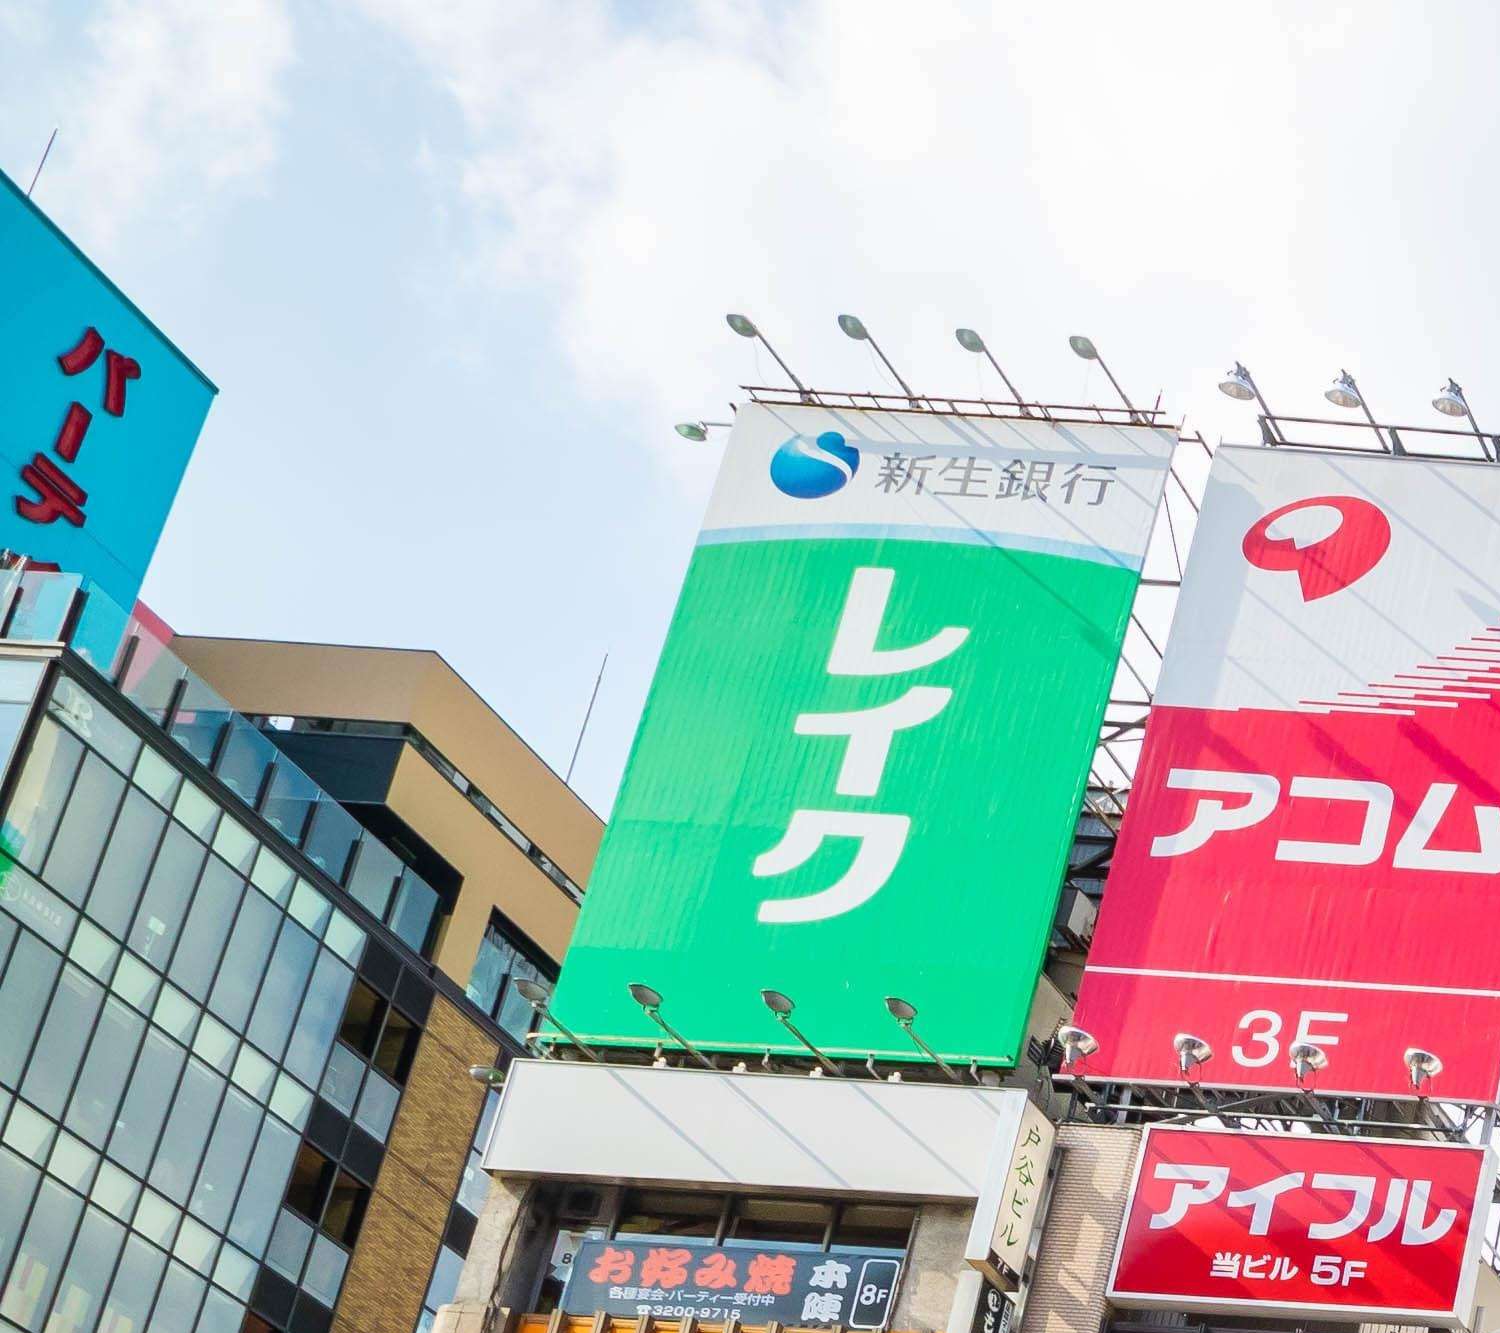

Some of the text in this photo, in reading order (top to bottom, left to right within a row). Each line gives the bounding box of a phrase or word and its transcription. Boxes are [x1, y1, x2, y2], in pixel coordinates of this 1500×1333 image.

[874, 452, 1118, 506] 新生銀行
[751, 567, 971, 924] レイク
[1230, 1009, 1349, 1070] 3F
[1000, 1125, 1042, 1248] 戸谷ビル
[1150, 1164, 1458, 1247] アイフル
[588, 1247, 800, 1295] お好み焼
[858, 1283, 890, 1309] 8F
[1209, 1252, 1368, 1286] 当ビル 5F
